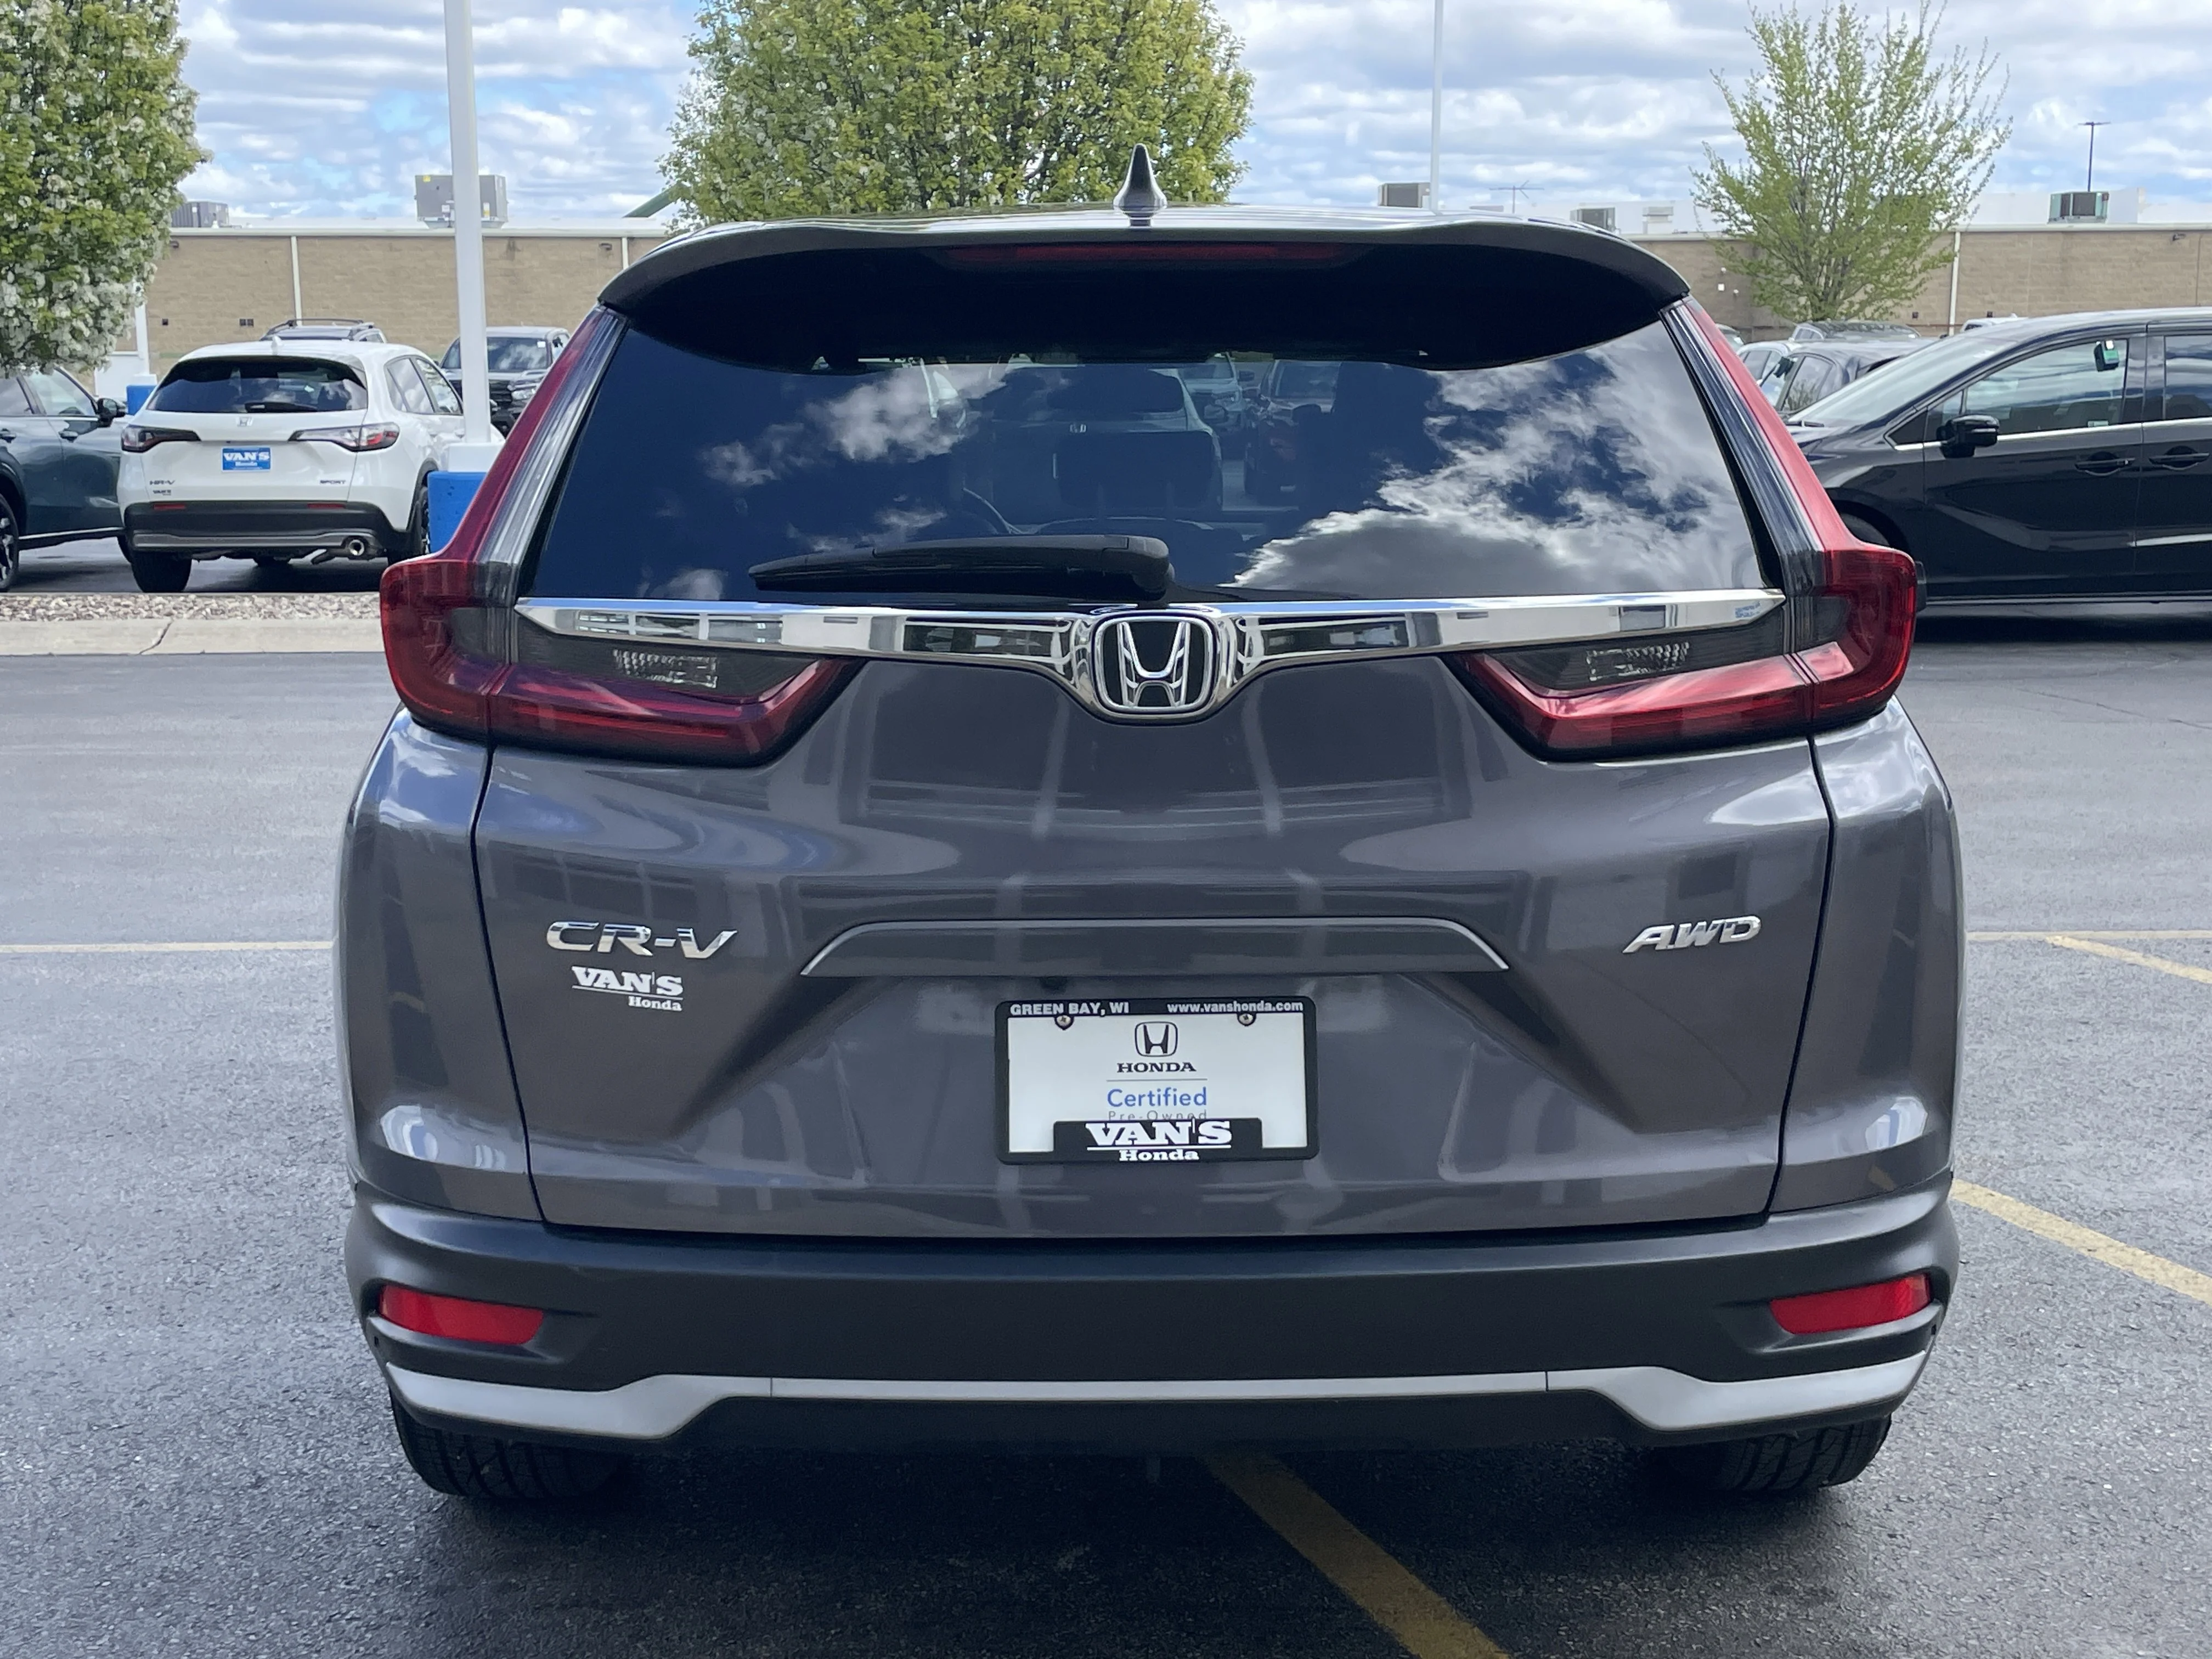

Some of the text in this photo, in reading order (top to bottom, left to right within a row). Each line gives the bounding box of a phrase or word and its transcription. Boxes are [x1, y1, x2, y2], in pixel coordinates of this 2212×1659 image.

[546, 921, 738, 959] CR-V
[1622, 916, 1762, 953] AWD
[628, 996, 682, 1012] Honda
[1010, 1002, 1129, 1016] GREEN BAY, WI
[1167, 1001, 1304, 1013] www.vanshonda.com
[1117, 1062, 1197, 1073] HONDA
[1107, 1086, 1207, 1107] Certified
[1085, 1118, 1232, 1146] VAN'S
[1119, 1149, 1200, 1161] Honda
